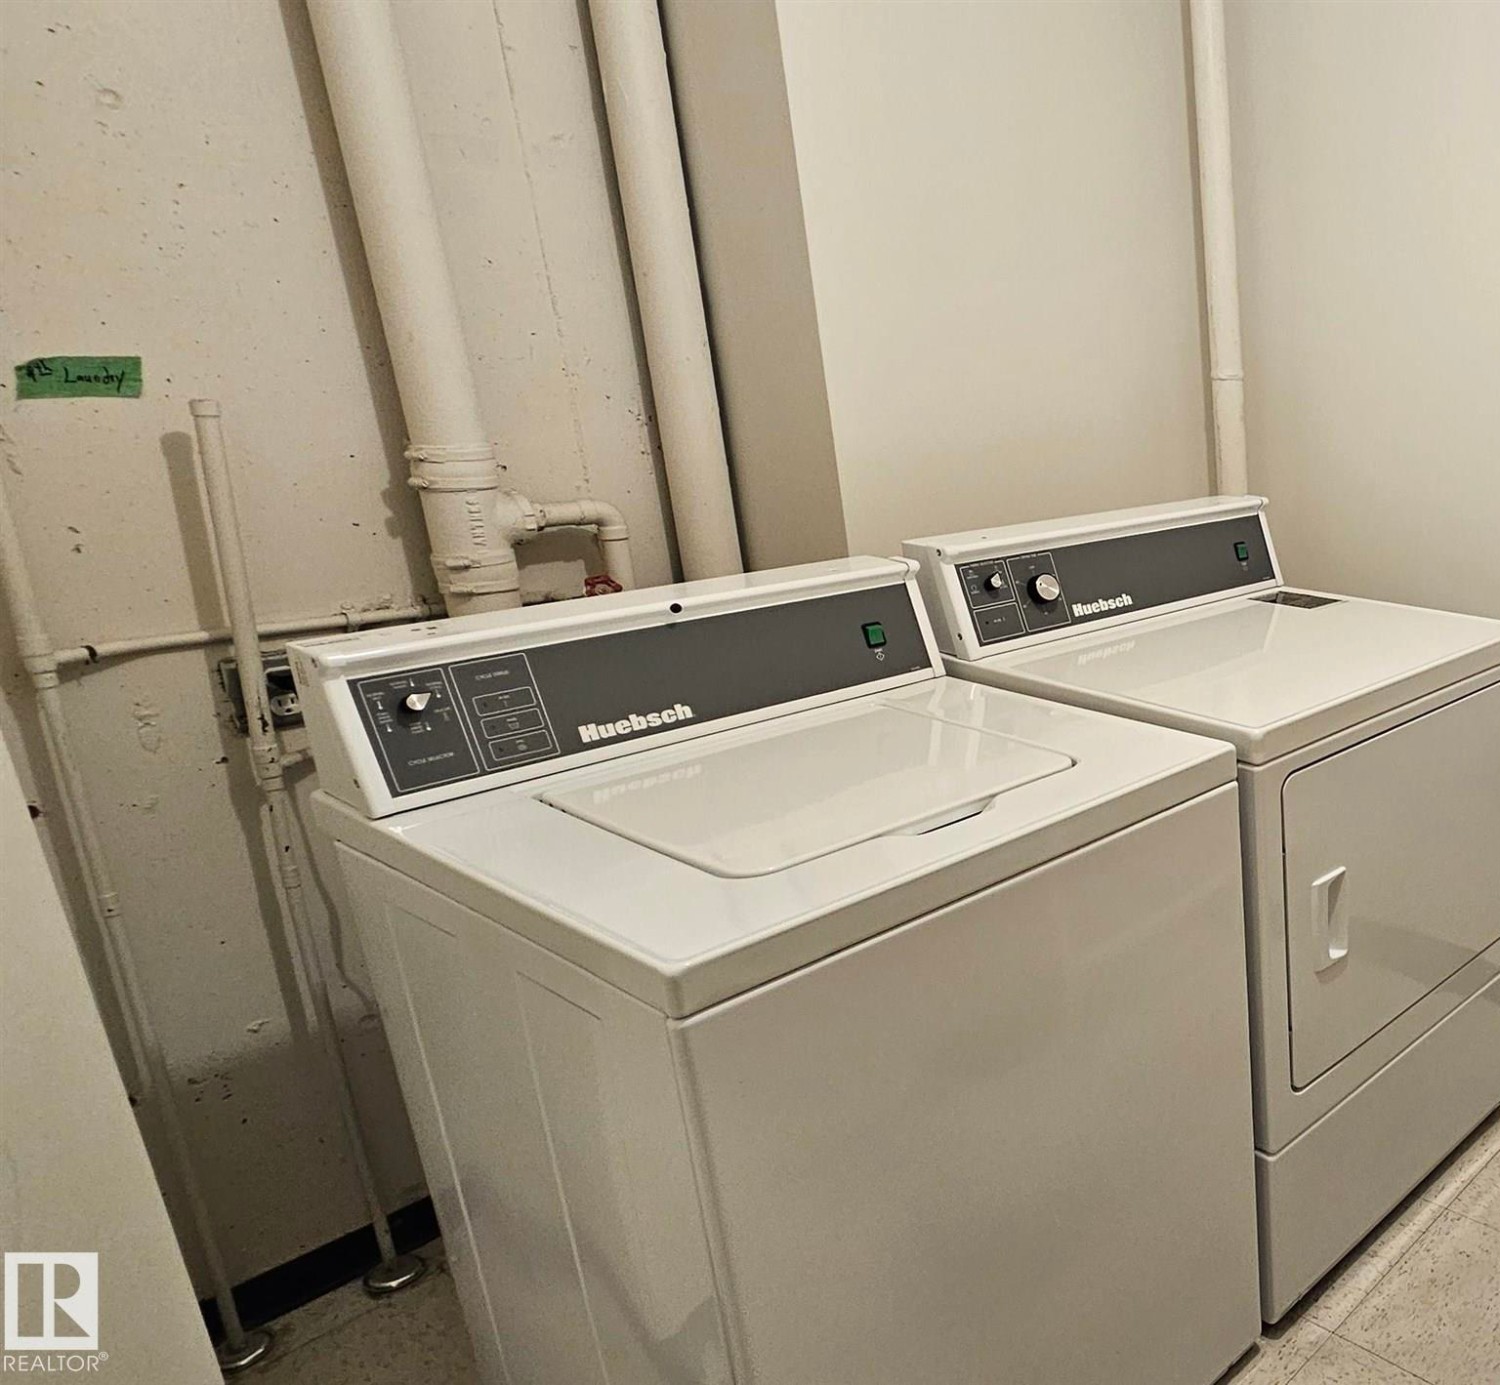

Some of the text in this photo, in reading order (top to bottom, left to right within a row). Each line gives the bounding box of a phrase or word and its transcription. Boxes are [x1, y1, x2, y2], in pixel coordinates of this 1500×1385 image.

[64, 366, 125, 394] Laundry
[1072, 593, 1133, 617] Huebsch
[577, 703, 694, 743] Huebsch
